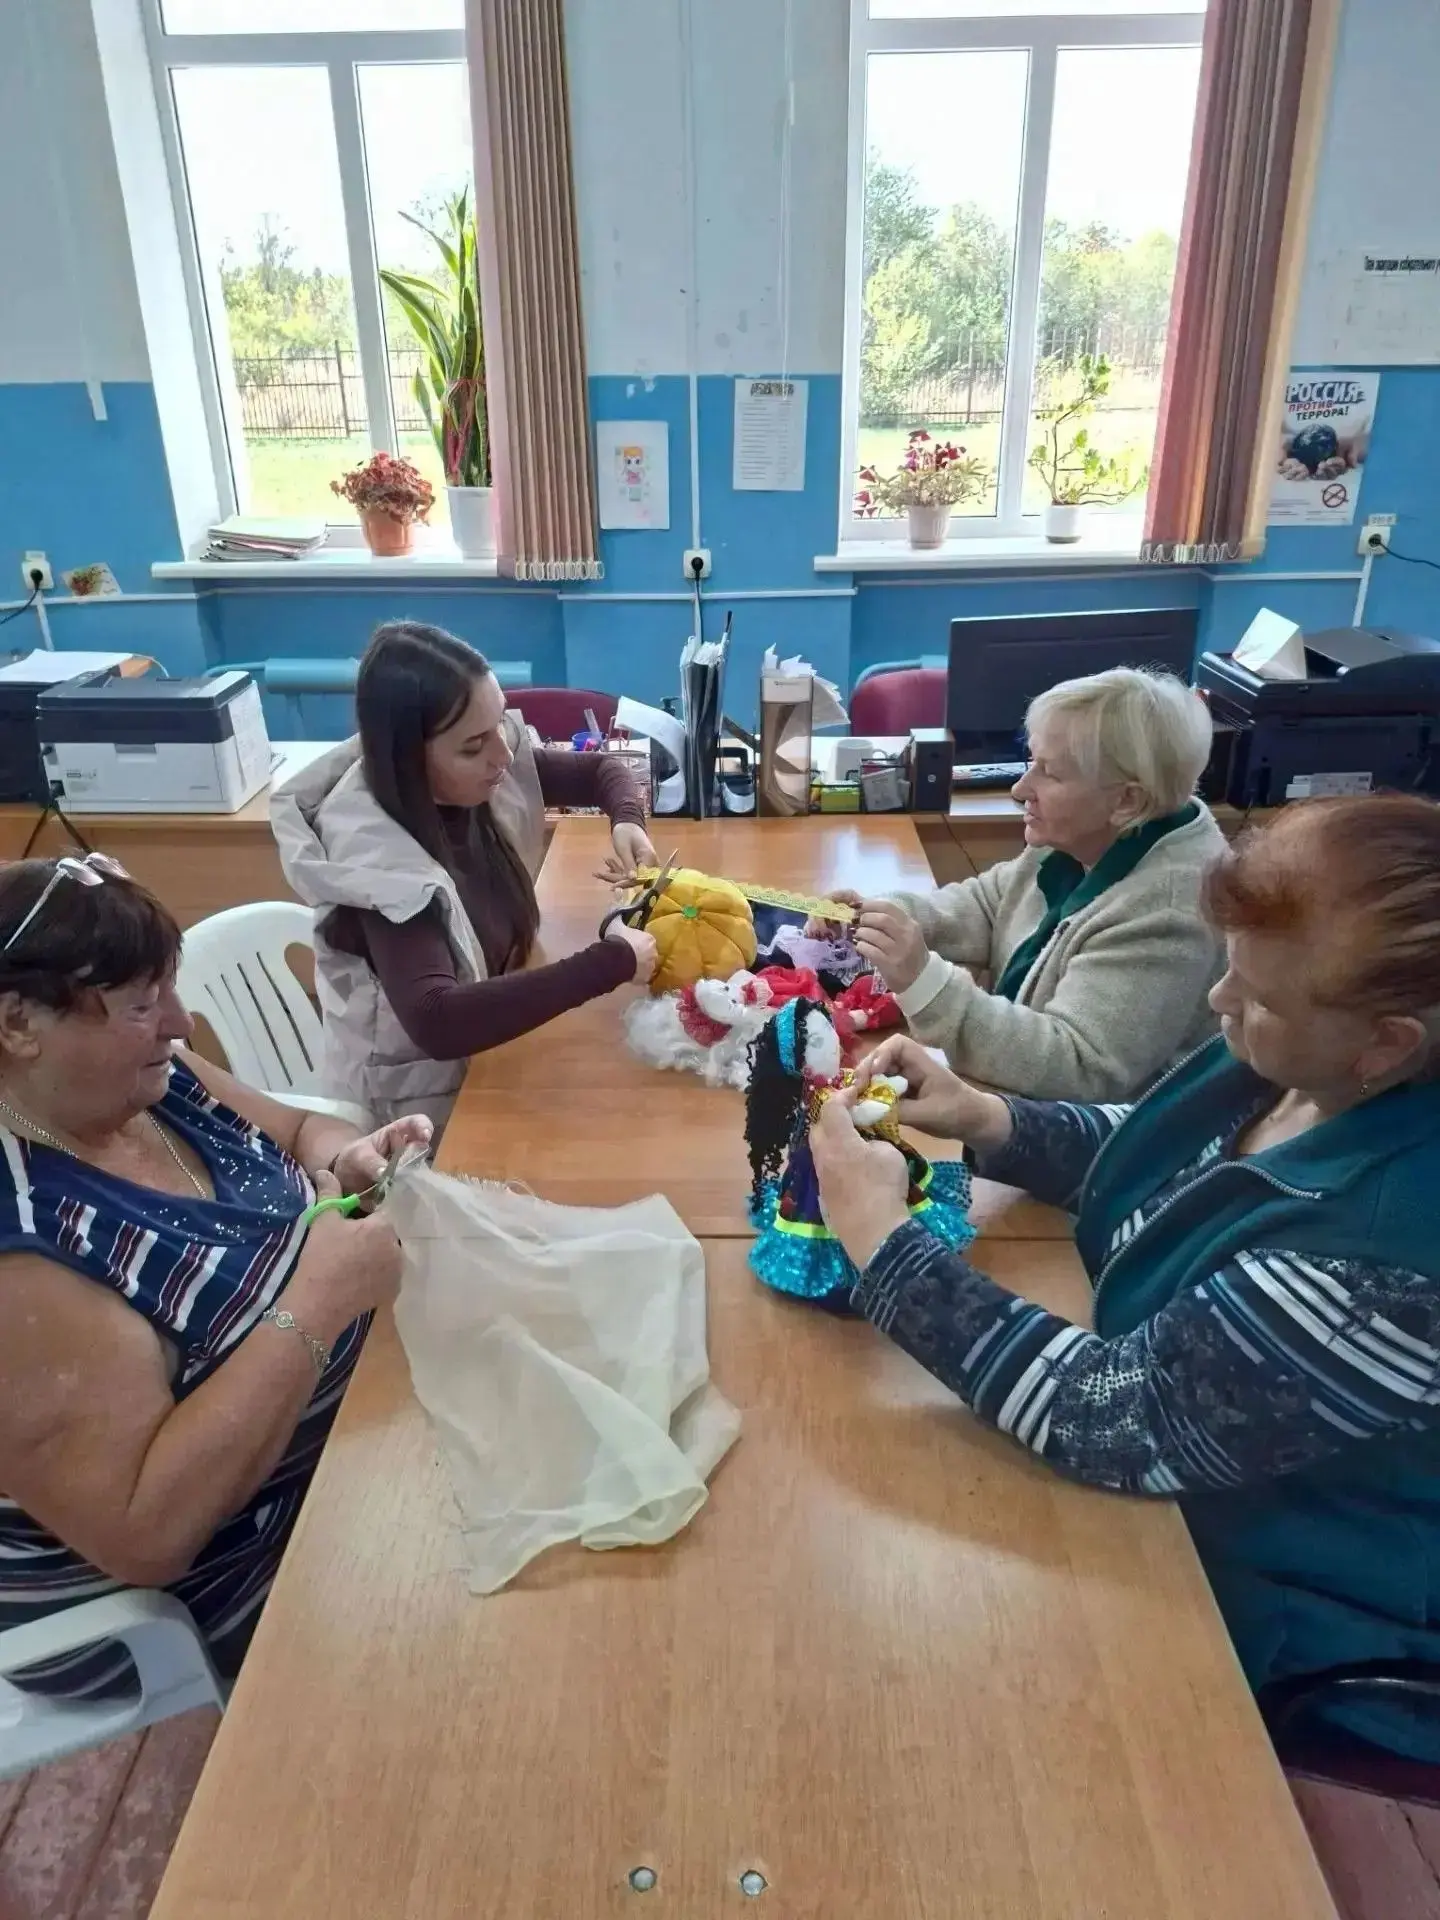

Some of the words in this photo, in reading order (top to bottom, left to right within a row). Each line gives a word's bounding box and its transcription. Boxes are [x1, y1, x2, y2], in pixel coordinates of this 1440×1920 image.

[1286, 382, 1361, 403] РОССИЯ
[1288, 400, 1334, 412] ПРОТИВ
[1296, 406, 1349, 420] ТЕРРОРА!
